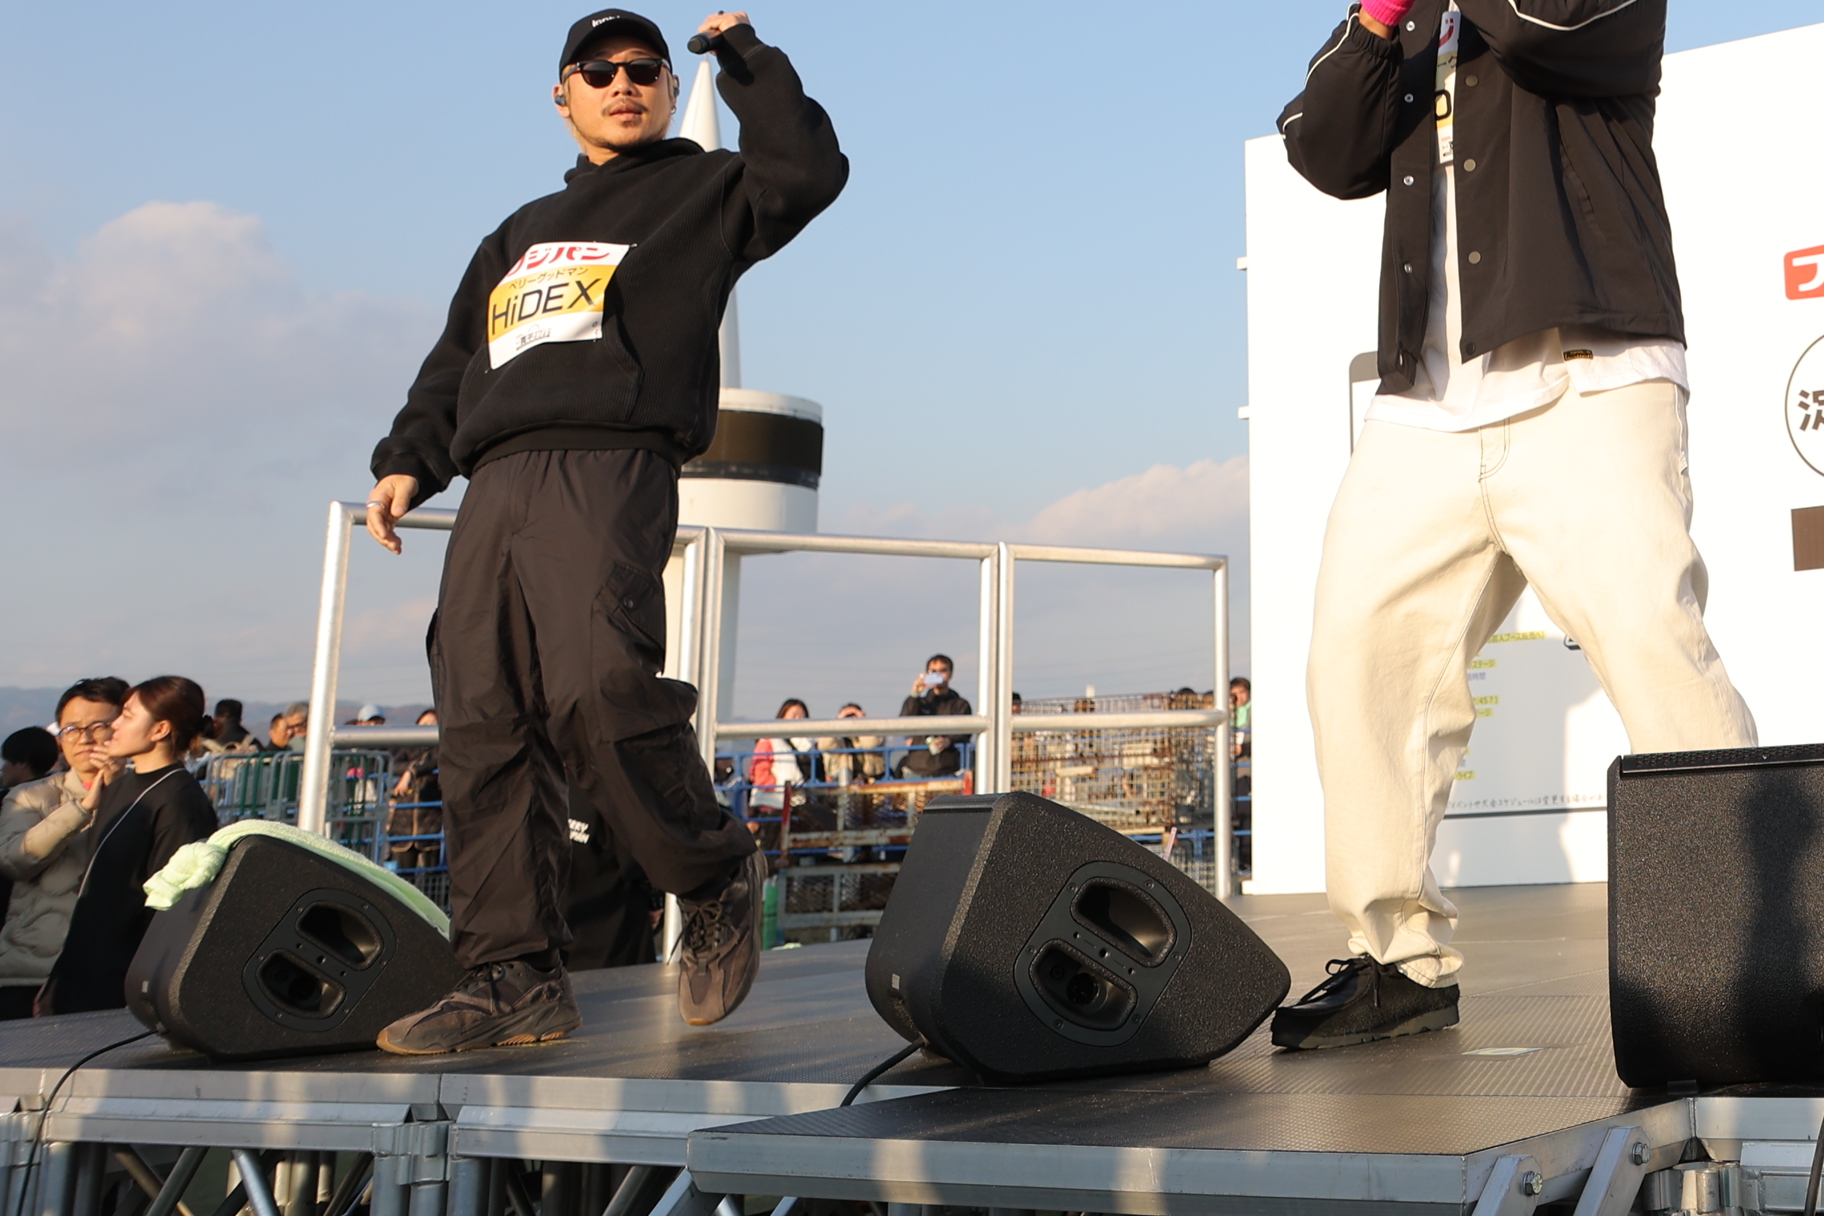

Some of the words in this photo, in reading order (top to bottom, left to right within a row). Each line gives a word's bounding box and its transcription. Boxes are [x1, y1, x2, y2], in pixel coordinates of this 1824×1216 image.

[508, 266, 589, 290] ベリーグッドマン
[491, 277, 603, 336] HiDEX
